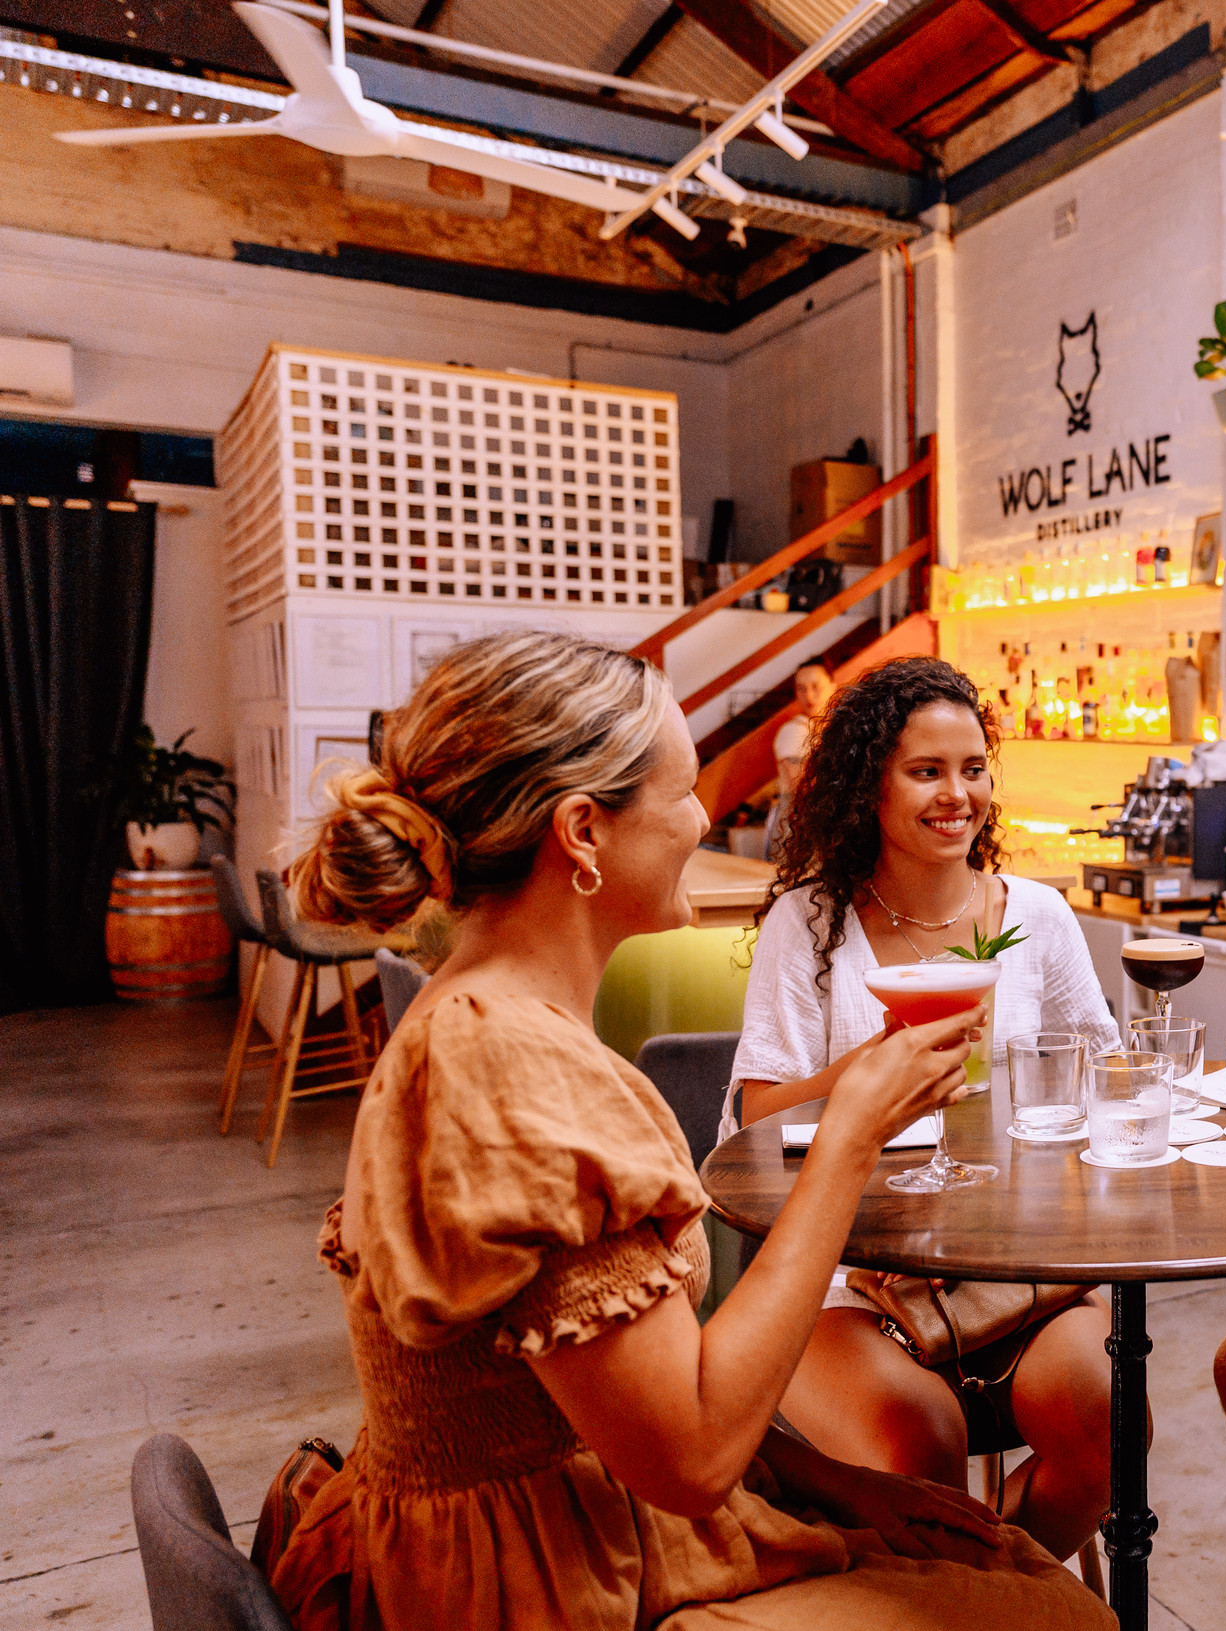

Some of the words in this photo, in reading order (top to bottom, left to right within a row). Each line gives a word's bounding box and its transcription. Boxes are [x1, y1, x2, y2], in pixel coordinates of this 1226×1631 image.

[999, 459, 1076, 517] WOLF
[1089, 434, 1171, 499] LANE
[1037, 508, 1123, 541] DISTILLERY
